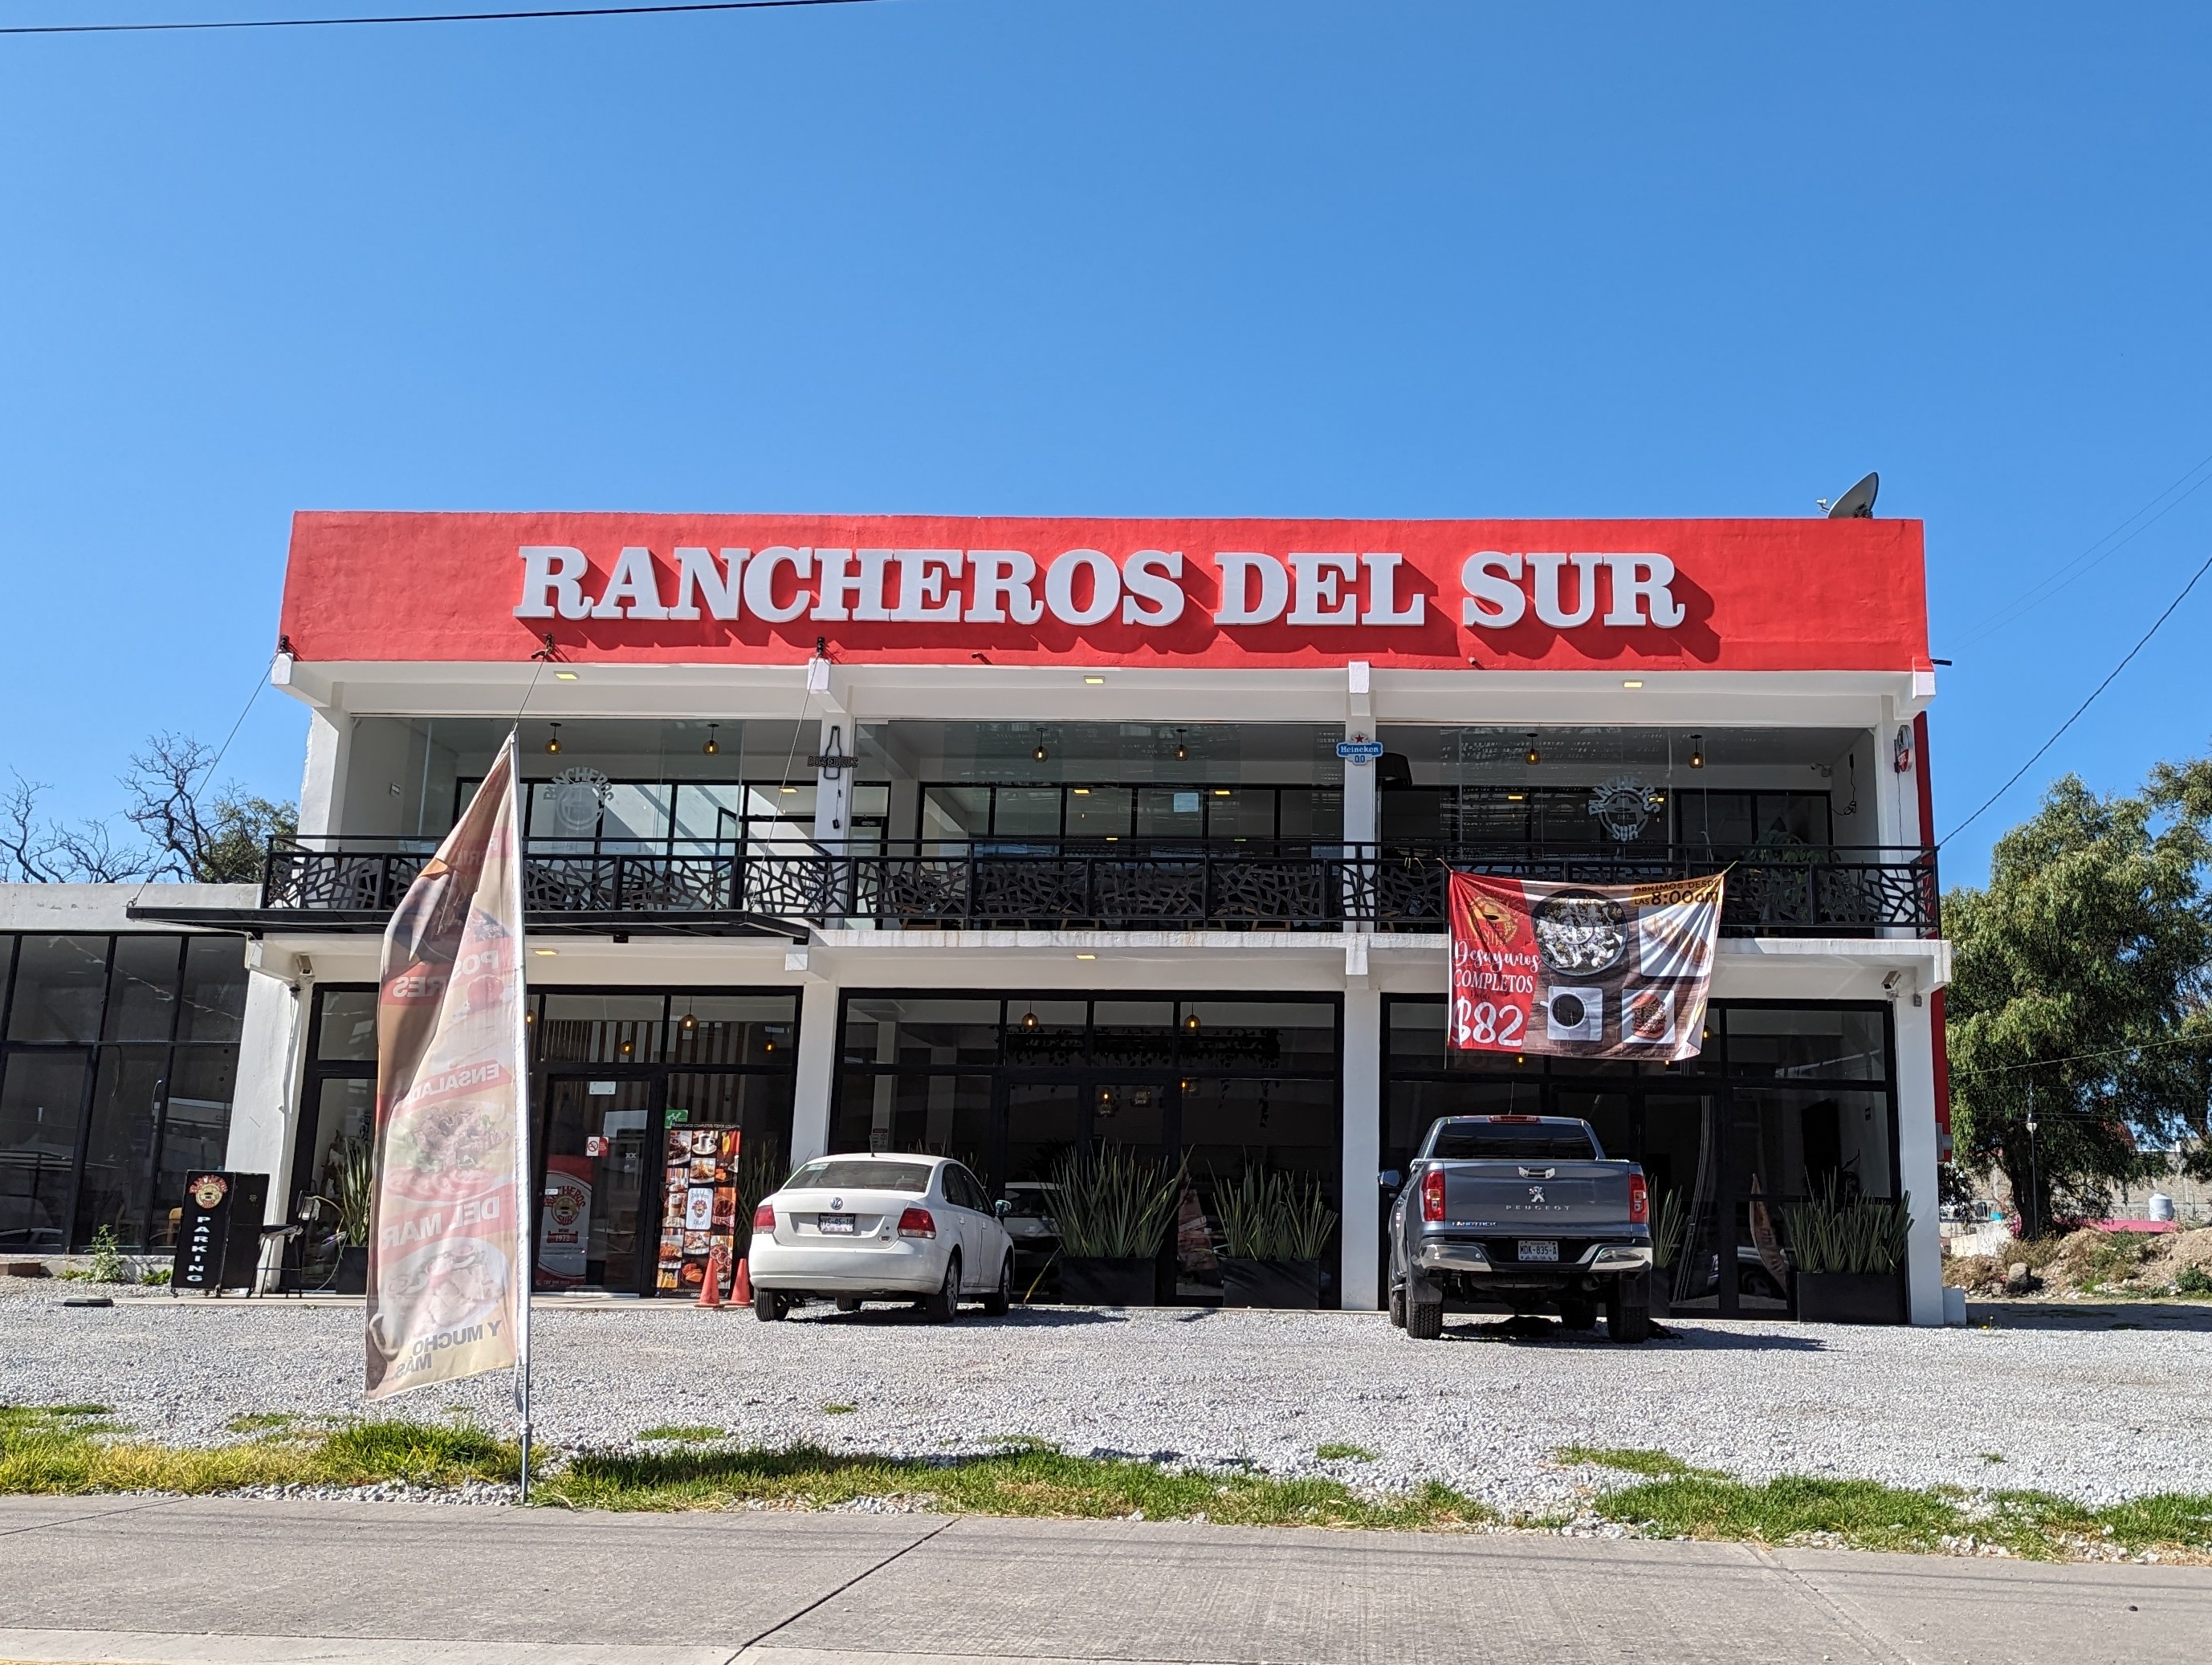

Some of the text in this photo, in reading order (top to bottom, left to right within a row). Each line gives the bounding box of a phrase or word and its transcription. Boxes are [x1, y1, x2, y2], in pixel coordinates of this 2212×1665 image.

[513, 546, 1685, 629] RANCHEROS DEL SUR
[1340, 745, 1379, 753] Heineken
[1611, 823, 1640, 841] SUR
[1454, 940, 1541, 973] Desayunos
[1453, 969, 1533, 994] COMPLETOS
[1451, 995, 1524, 1048] $82
[186, 1216, 211, 1282] PARKING
